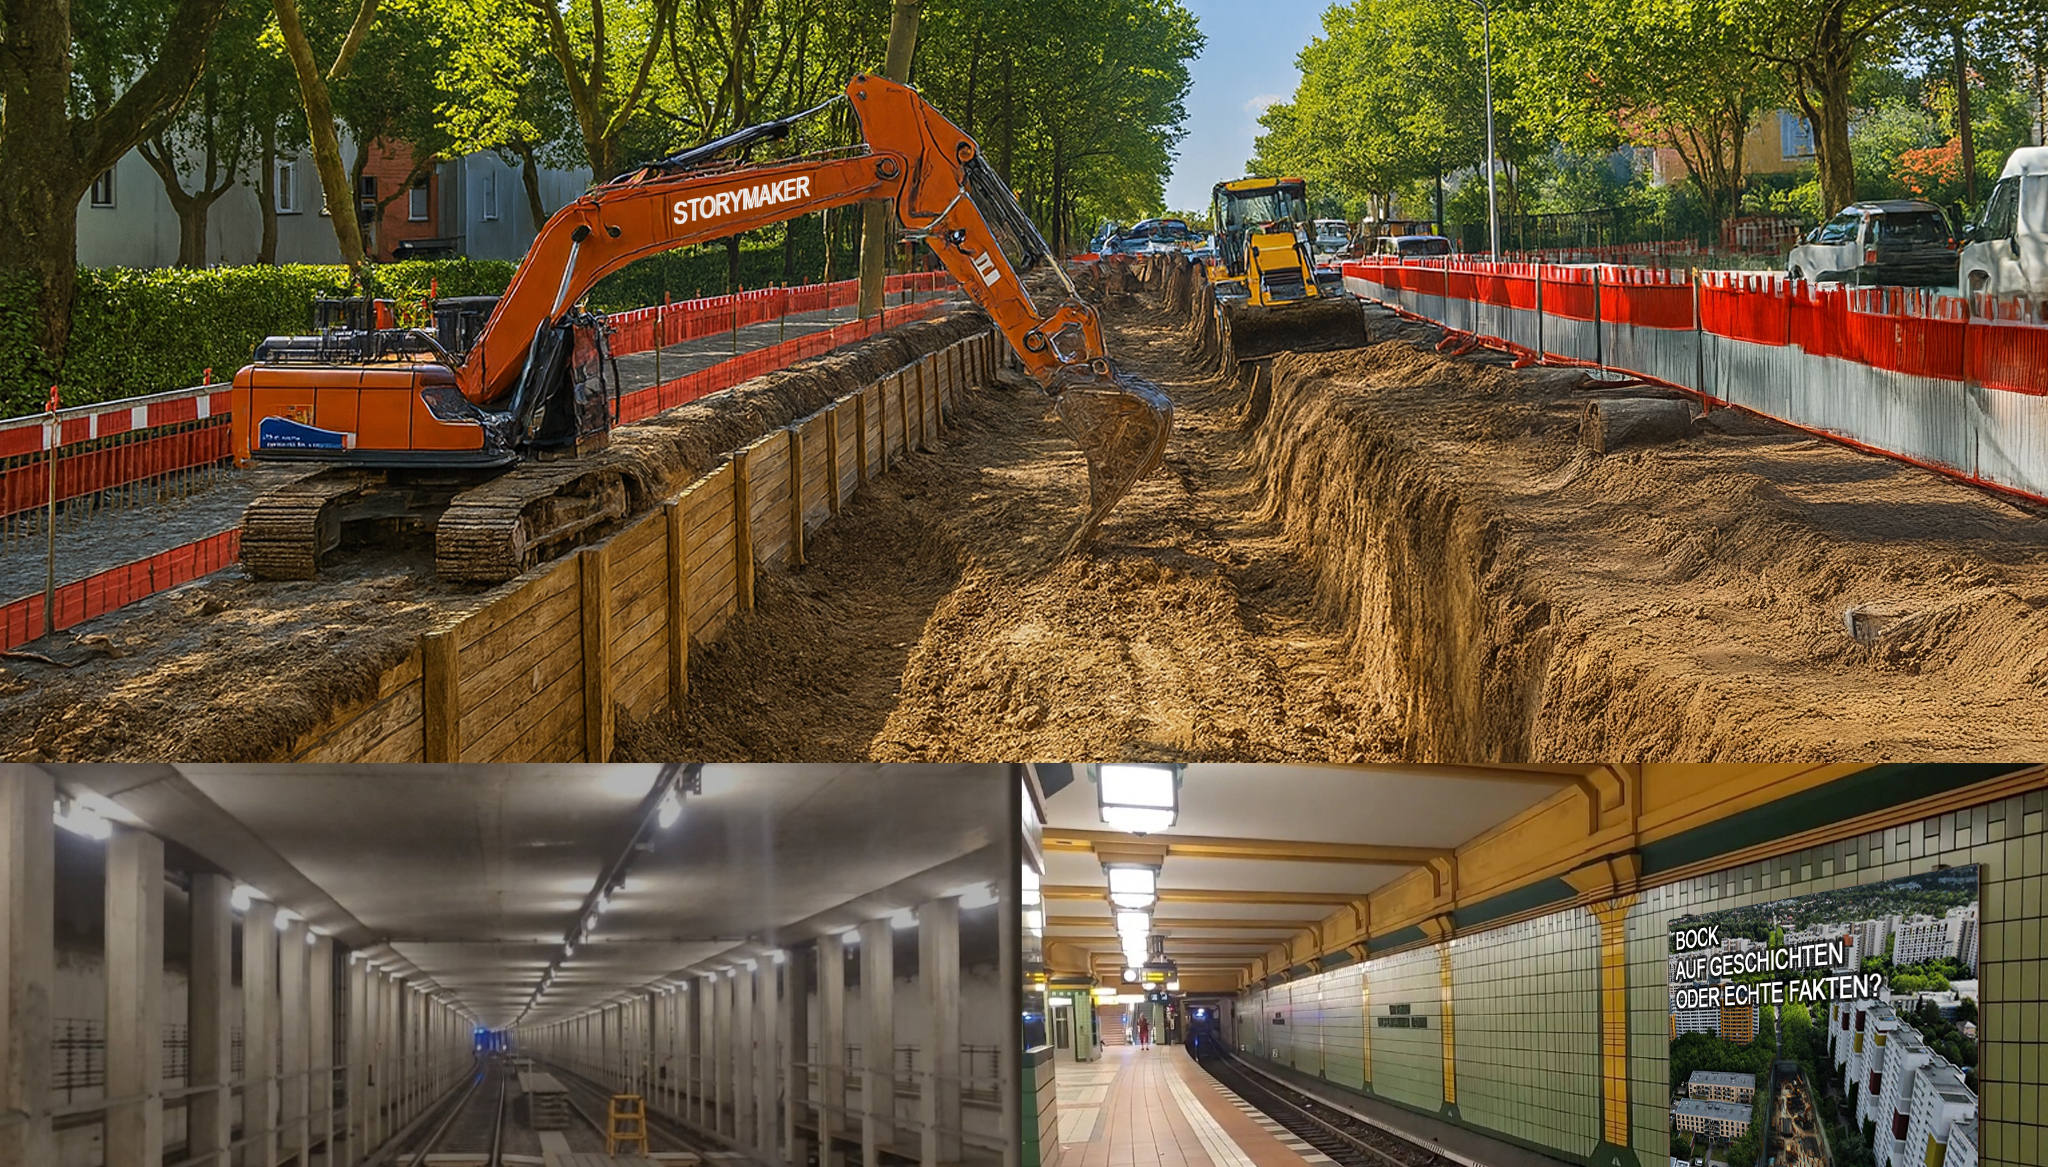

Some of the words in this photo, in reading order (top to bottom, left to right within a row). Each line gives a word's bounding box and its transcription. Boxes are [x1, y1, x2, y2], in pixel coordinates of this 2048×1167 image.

[673, 175, 811, 225] STORYMAKER
[1676, 925, 1719, 951] BOCK
[1675, 957, 1706, 981] AUF
[1710, 941, 1843, 977] GESCHICHTEN
[1676, 987, 1720, 1009] ODER
[1724, 981, 1784, 1006] ECHTE
[1789, 973, 1882, 1002] FAKTEN?
